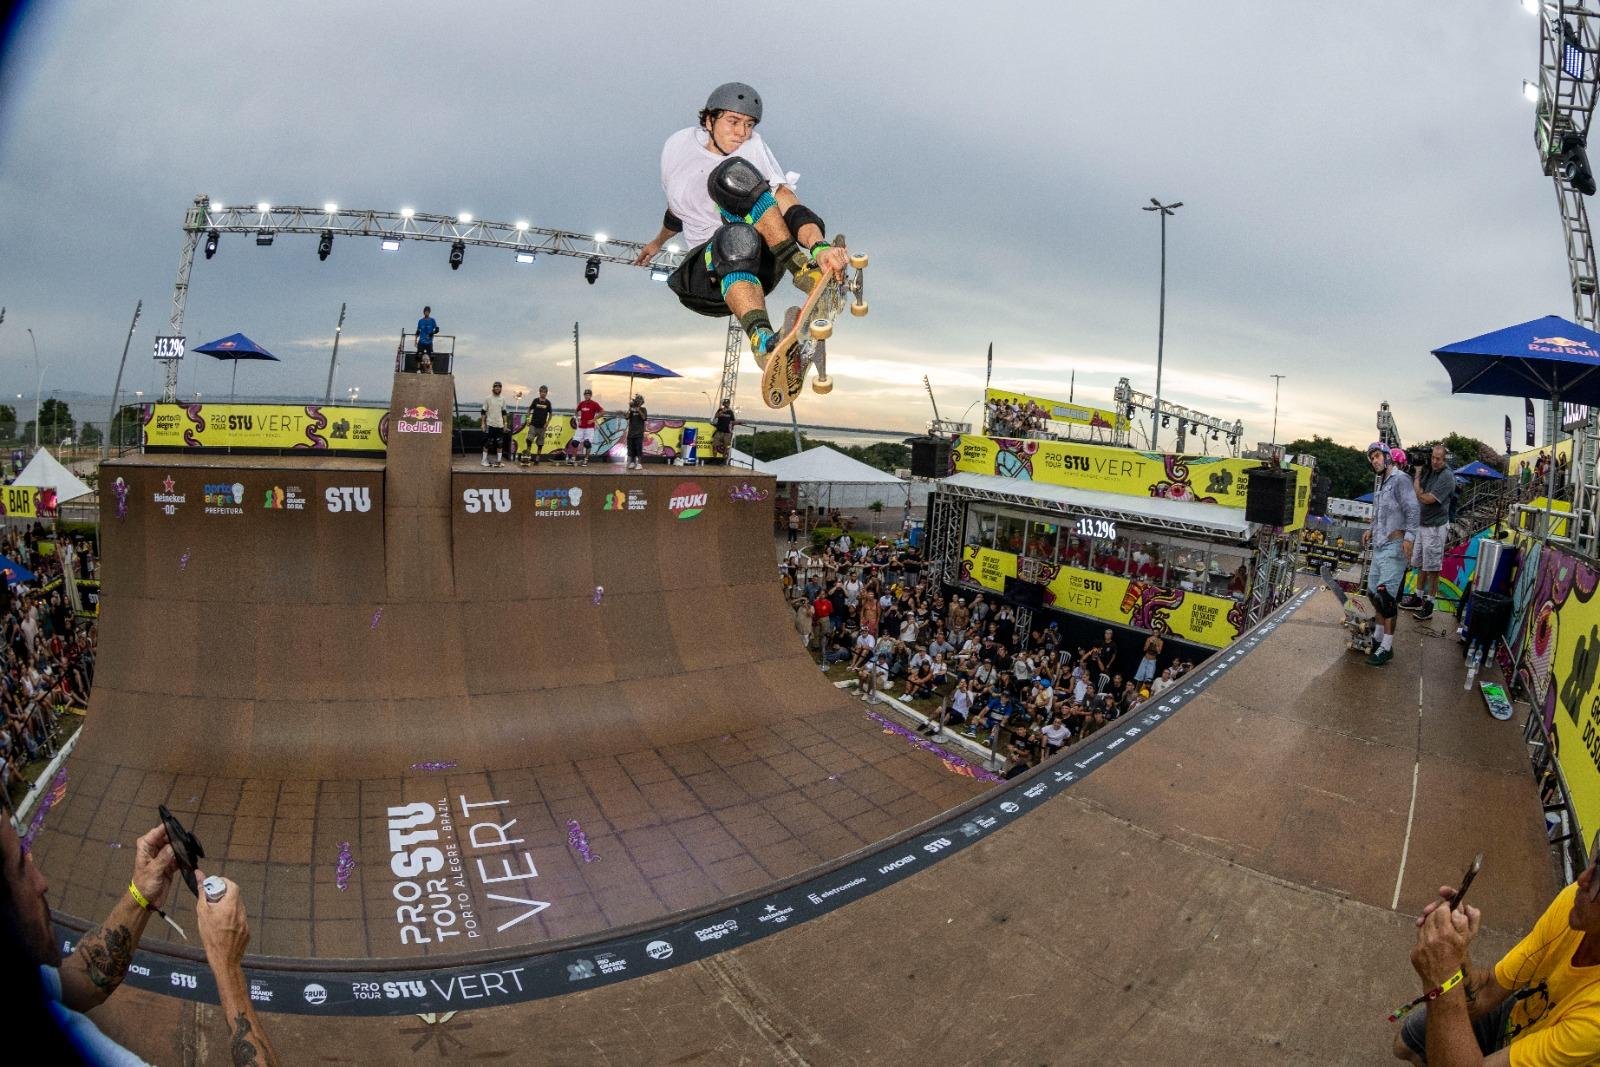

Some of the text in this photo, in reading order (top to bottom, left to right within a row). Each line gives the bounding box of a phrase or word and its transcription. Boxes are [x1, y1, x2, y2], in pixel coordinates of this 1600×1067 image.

[154, 338, 185, 357] :13.296
[1528, 343, 1600, 358] Red Bull
[229, 415, 303, 432] STU VERT
[398, 421, 442, 433] Red Bull
[1045, 453, 1062, 461] PRO
[1064, 455, 1089, 471] STU
[1095, 458, 1146, 478] VERT
[204, 483, 232, 494] porto
[535, 488, 569, 498] porto
[9, 489, 30, 513] BAR
[154, 493, 186, 503] Heineken
[204, 494, 232, 506] alegre
[325, 487, 371, 512] STU
[463, 488, 511, 513] STU
[535, 497, 568, 510] alegre
[668, 493, 708, 510] FRUKI
[205, 507, 243, 515] PREFEITURA
[1076, 518, 1116, 540] :13.296
[1084, 578, 1102, 592] STU
[1068, 592, 1101, 608] VERT
[1582, 720, 1595, 749] DO
[387, 802, 445, 878] STU
[923, 837, 952, 853] STU
[438, 797, 480, 938] PORTO ALEGRE BRAZIL
[459, 794, 551, 933] VERT
[878, 854, 917, 874] IMOBI
[392, 881, 432, 944] PRO
[426, 878, 461, 943] TOUR
[758, 906, 795, 922] Heineken
[694, 923, 724, 938] porto
[700, 928, 729, 942] alegre
[128, 964, 150, 977] OBI
[600, 959, 627, 970] GRANDE
[170, 972, 197, 989] STU
[352, 982, 380, 992] PRO
[382, 967, 525, 1001] STU VERT
[303, 989, 328, 998] FRUKI
[353, 991, 382, 1000] TOUR
